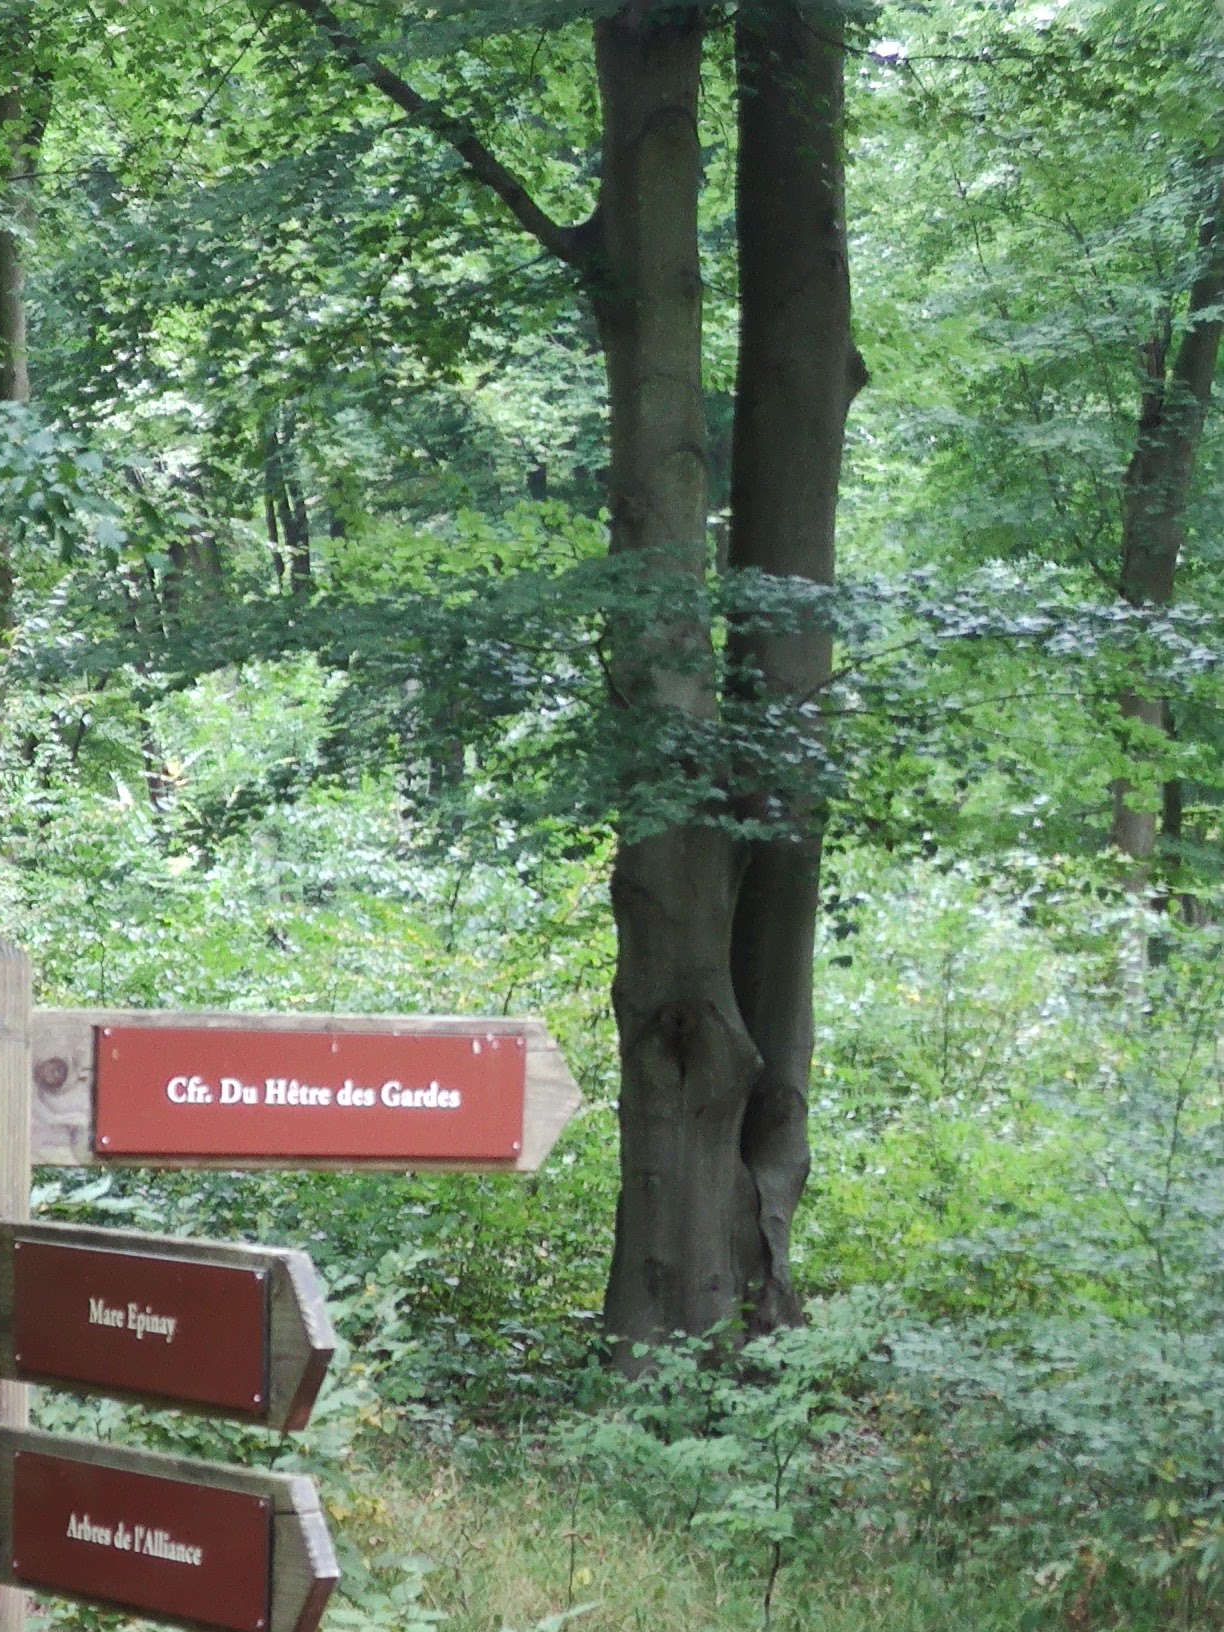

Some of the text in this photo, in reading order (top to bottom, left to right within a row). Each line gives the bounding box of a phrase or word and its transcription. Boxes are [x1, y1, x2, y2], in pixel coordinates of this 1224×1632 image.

[166, 1075, 462, 1109] Cfr. Du Hêtre des Gardes
[88, 1297, 177, 1344] Mare Epinay
[66, 1513, 203, 1566] Arbres de l'Alliance
